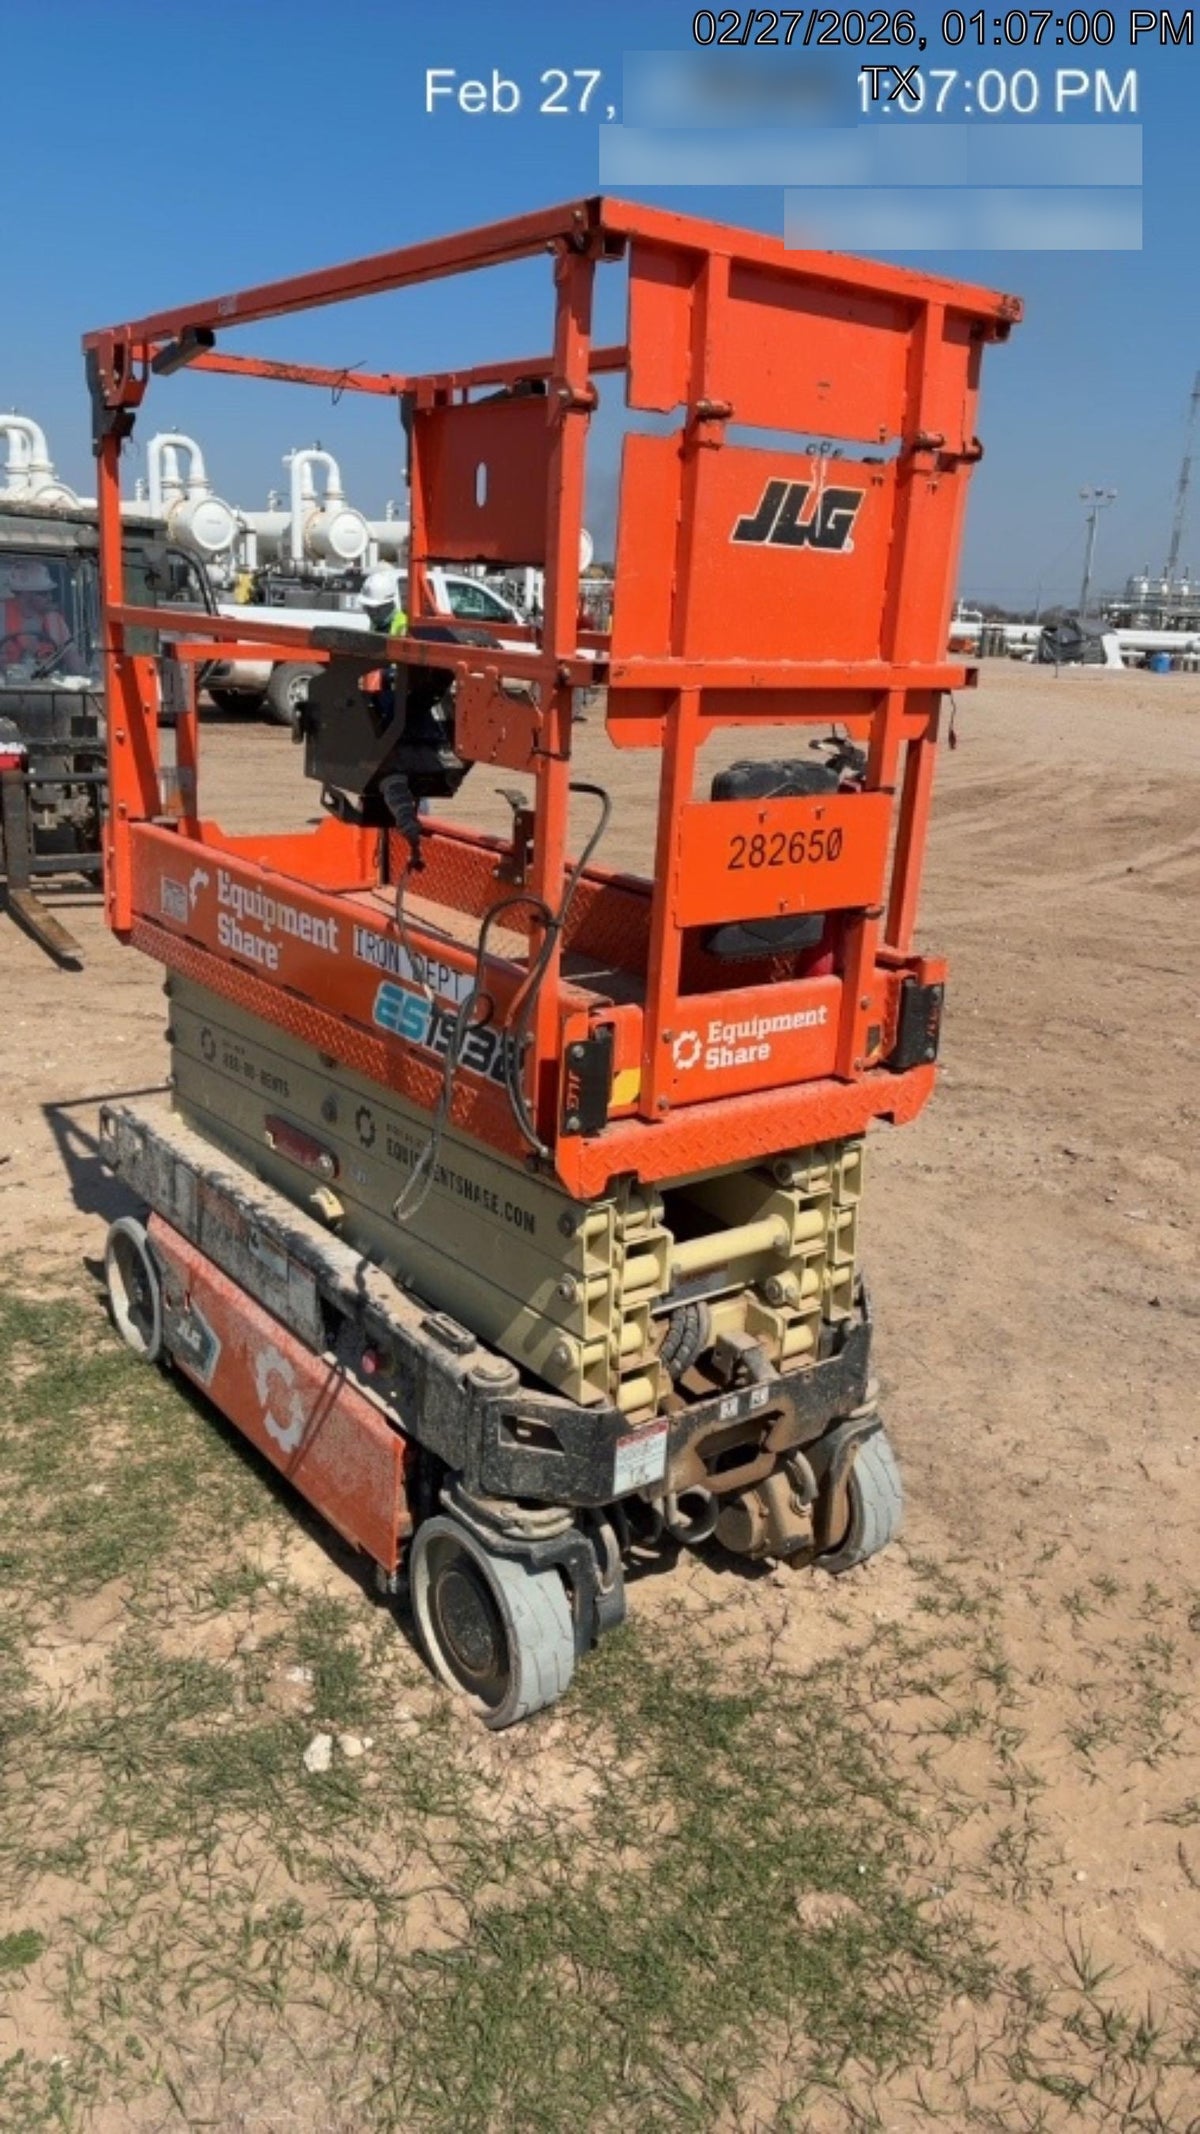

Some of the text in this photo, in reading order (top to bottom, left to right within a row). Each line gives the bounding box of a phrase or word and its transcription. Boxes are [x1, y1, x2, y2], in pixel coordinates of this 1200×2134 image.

[729, 476, 865, 552] JLG
[727, 827, 843, 870] 282650
[217, 868, 339, 954] Equipment
[217, 912, 279, 970] Share
[357, 928, 400, 972] IRON
[707, 1005, 828, 1046] Equipment
[704, 1041, 770, 1070] Share
